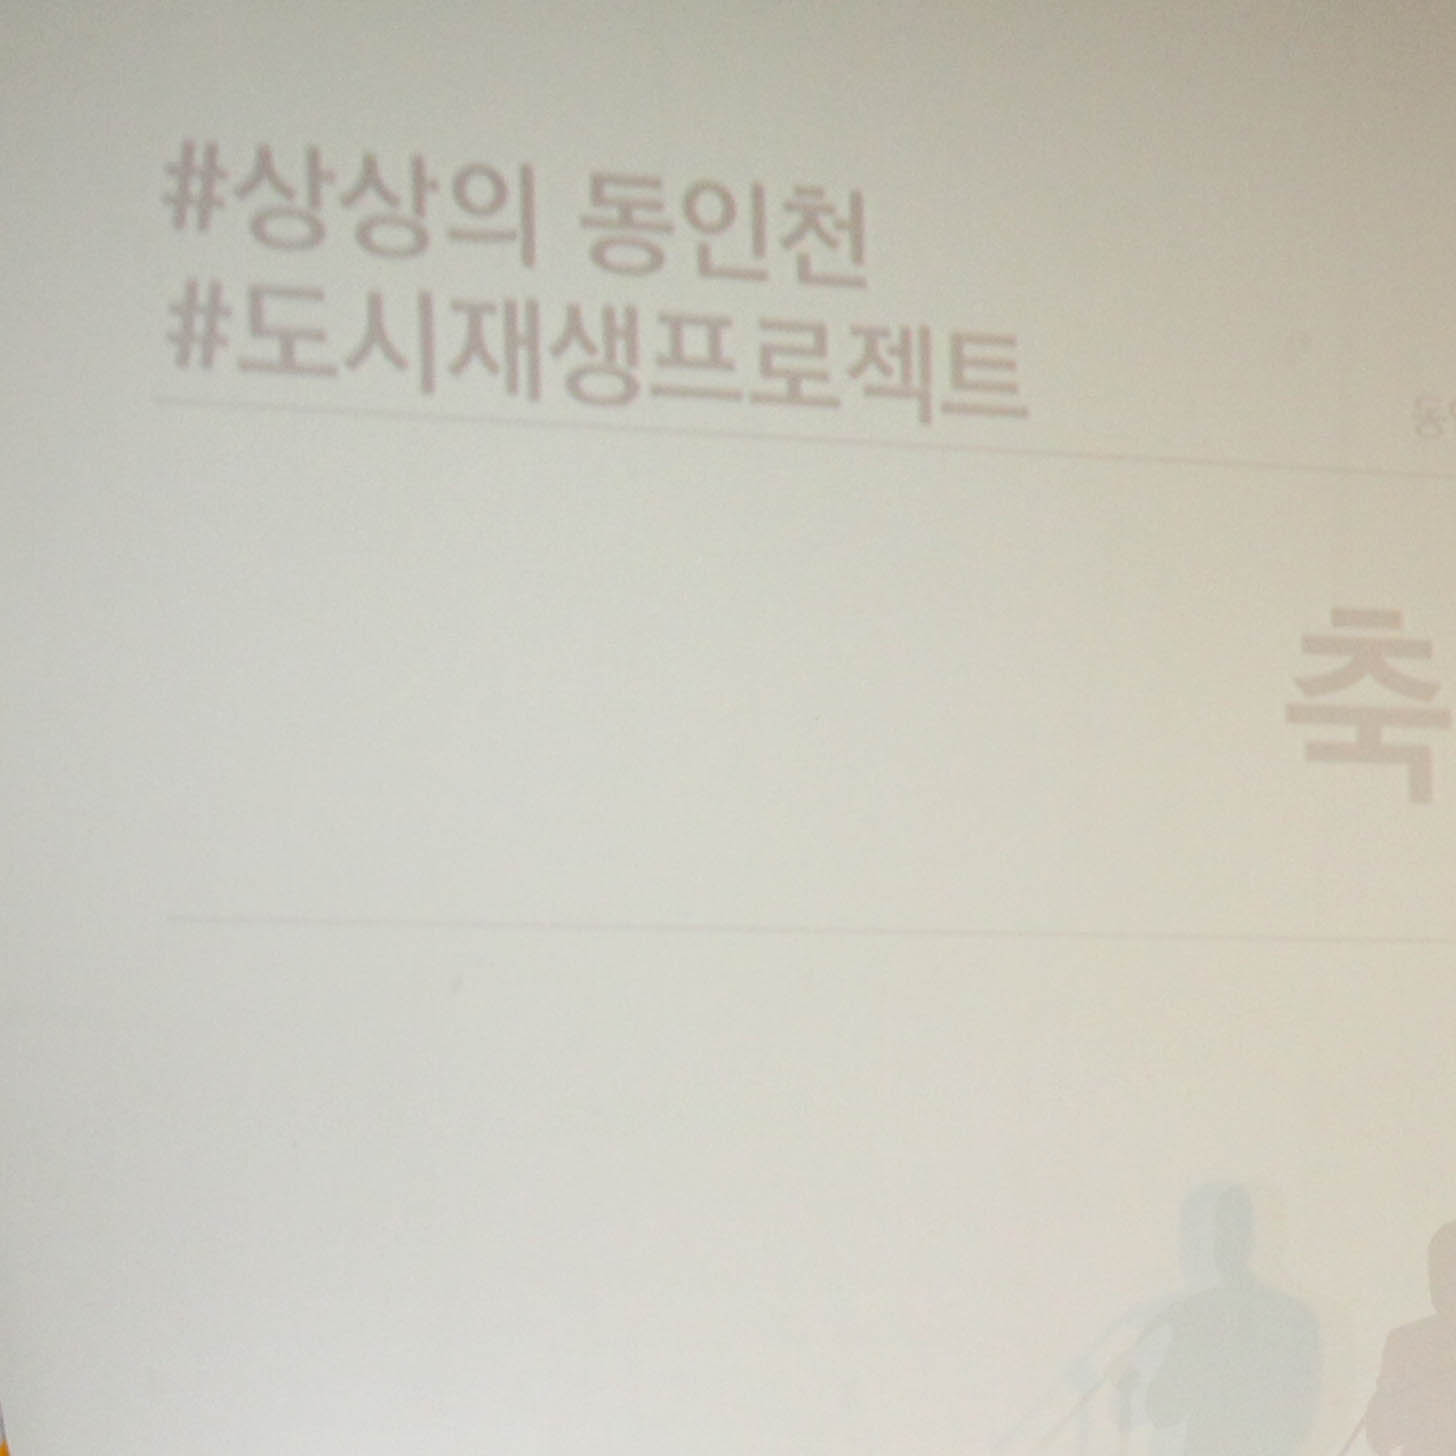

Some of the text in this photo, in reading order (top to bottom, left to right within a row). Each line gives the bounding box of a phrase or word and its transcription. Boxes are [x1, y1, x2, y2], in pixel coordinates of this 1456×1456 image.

[159, 138, 866, 289] #상상의 동인천
[165, 279, 1030, 424] #도시재생프로젝트
